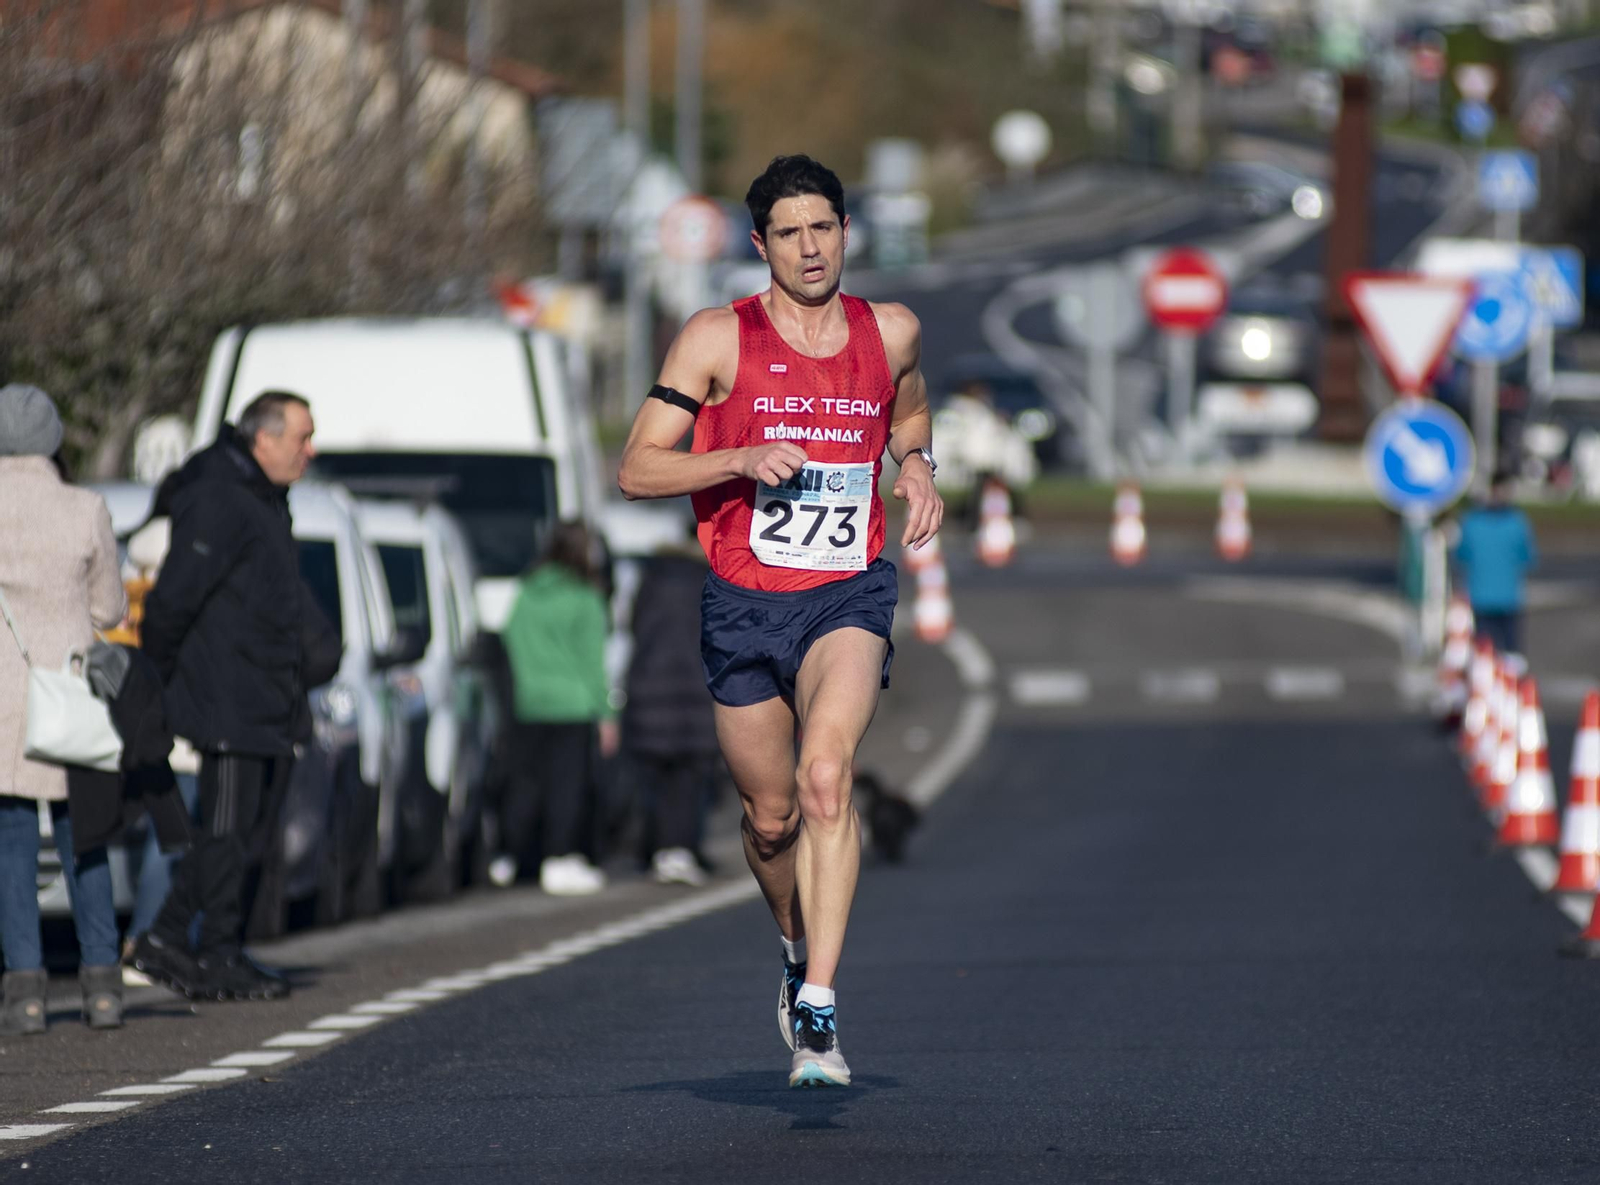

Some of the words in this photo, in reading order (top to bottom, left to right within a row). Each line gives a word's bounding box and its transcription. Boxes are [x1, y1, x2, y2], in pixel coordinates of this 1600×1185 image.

[753, 396, 815, 413] ALEX
[820, 398, 881, 417] TEAM
[763, 421, 864, 443] RUNMANIAK
[759, 499, 858, 548] 273
